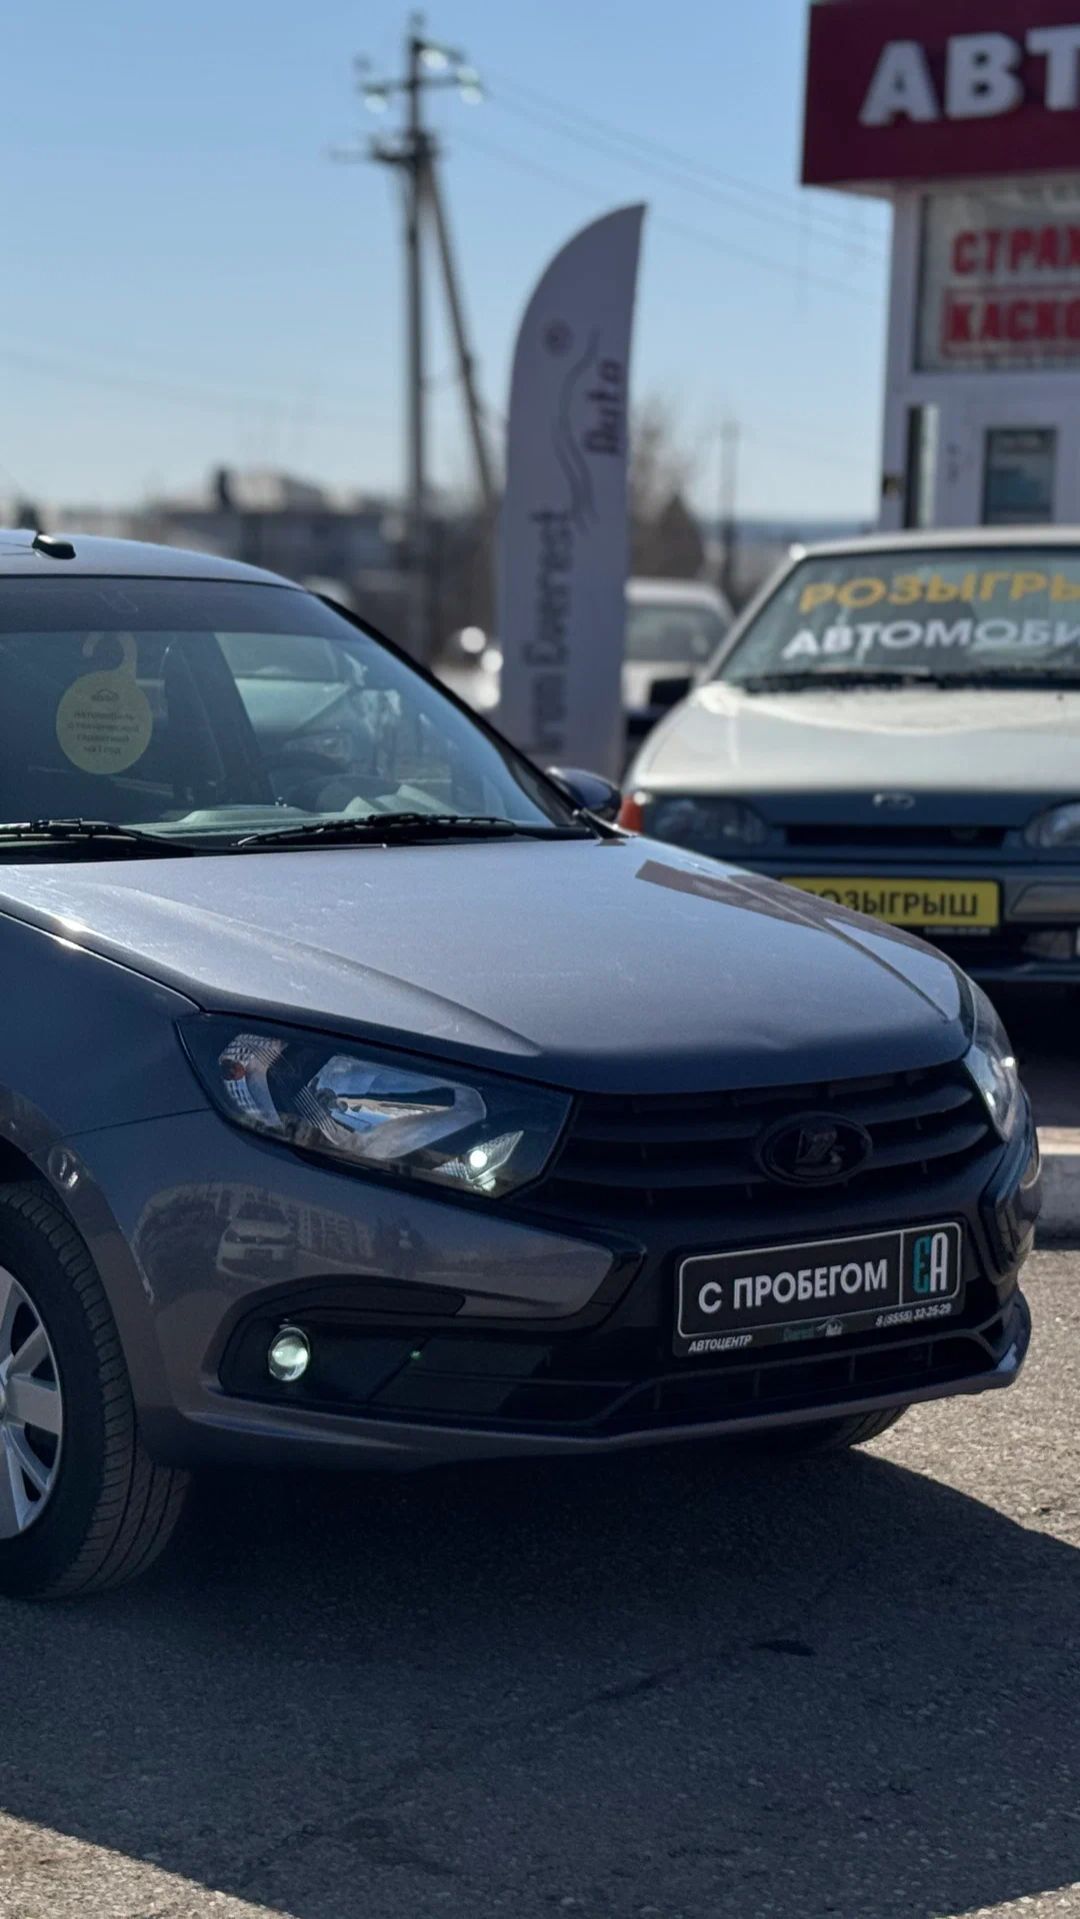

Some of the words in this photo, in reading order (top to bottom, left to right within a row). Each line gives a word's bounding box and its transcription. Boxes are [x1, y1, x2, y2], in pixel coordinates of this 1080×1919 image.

[805, 888, 979, 917] ЗЫГРЫШ
[698, 1281, 722, 1314] С
[733, 1259, 888, 1309] ПРОБЕГОМ
[688, 1335, 753, 1353] АВТОЦЕНТР
